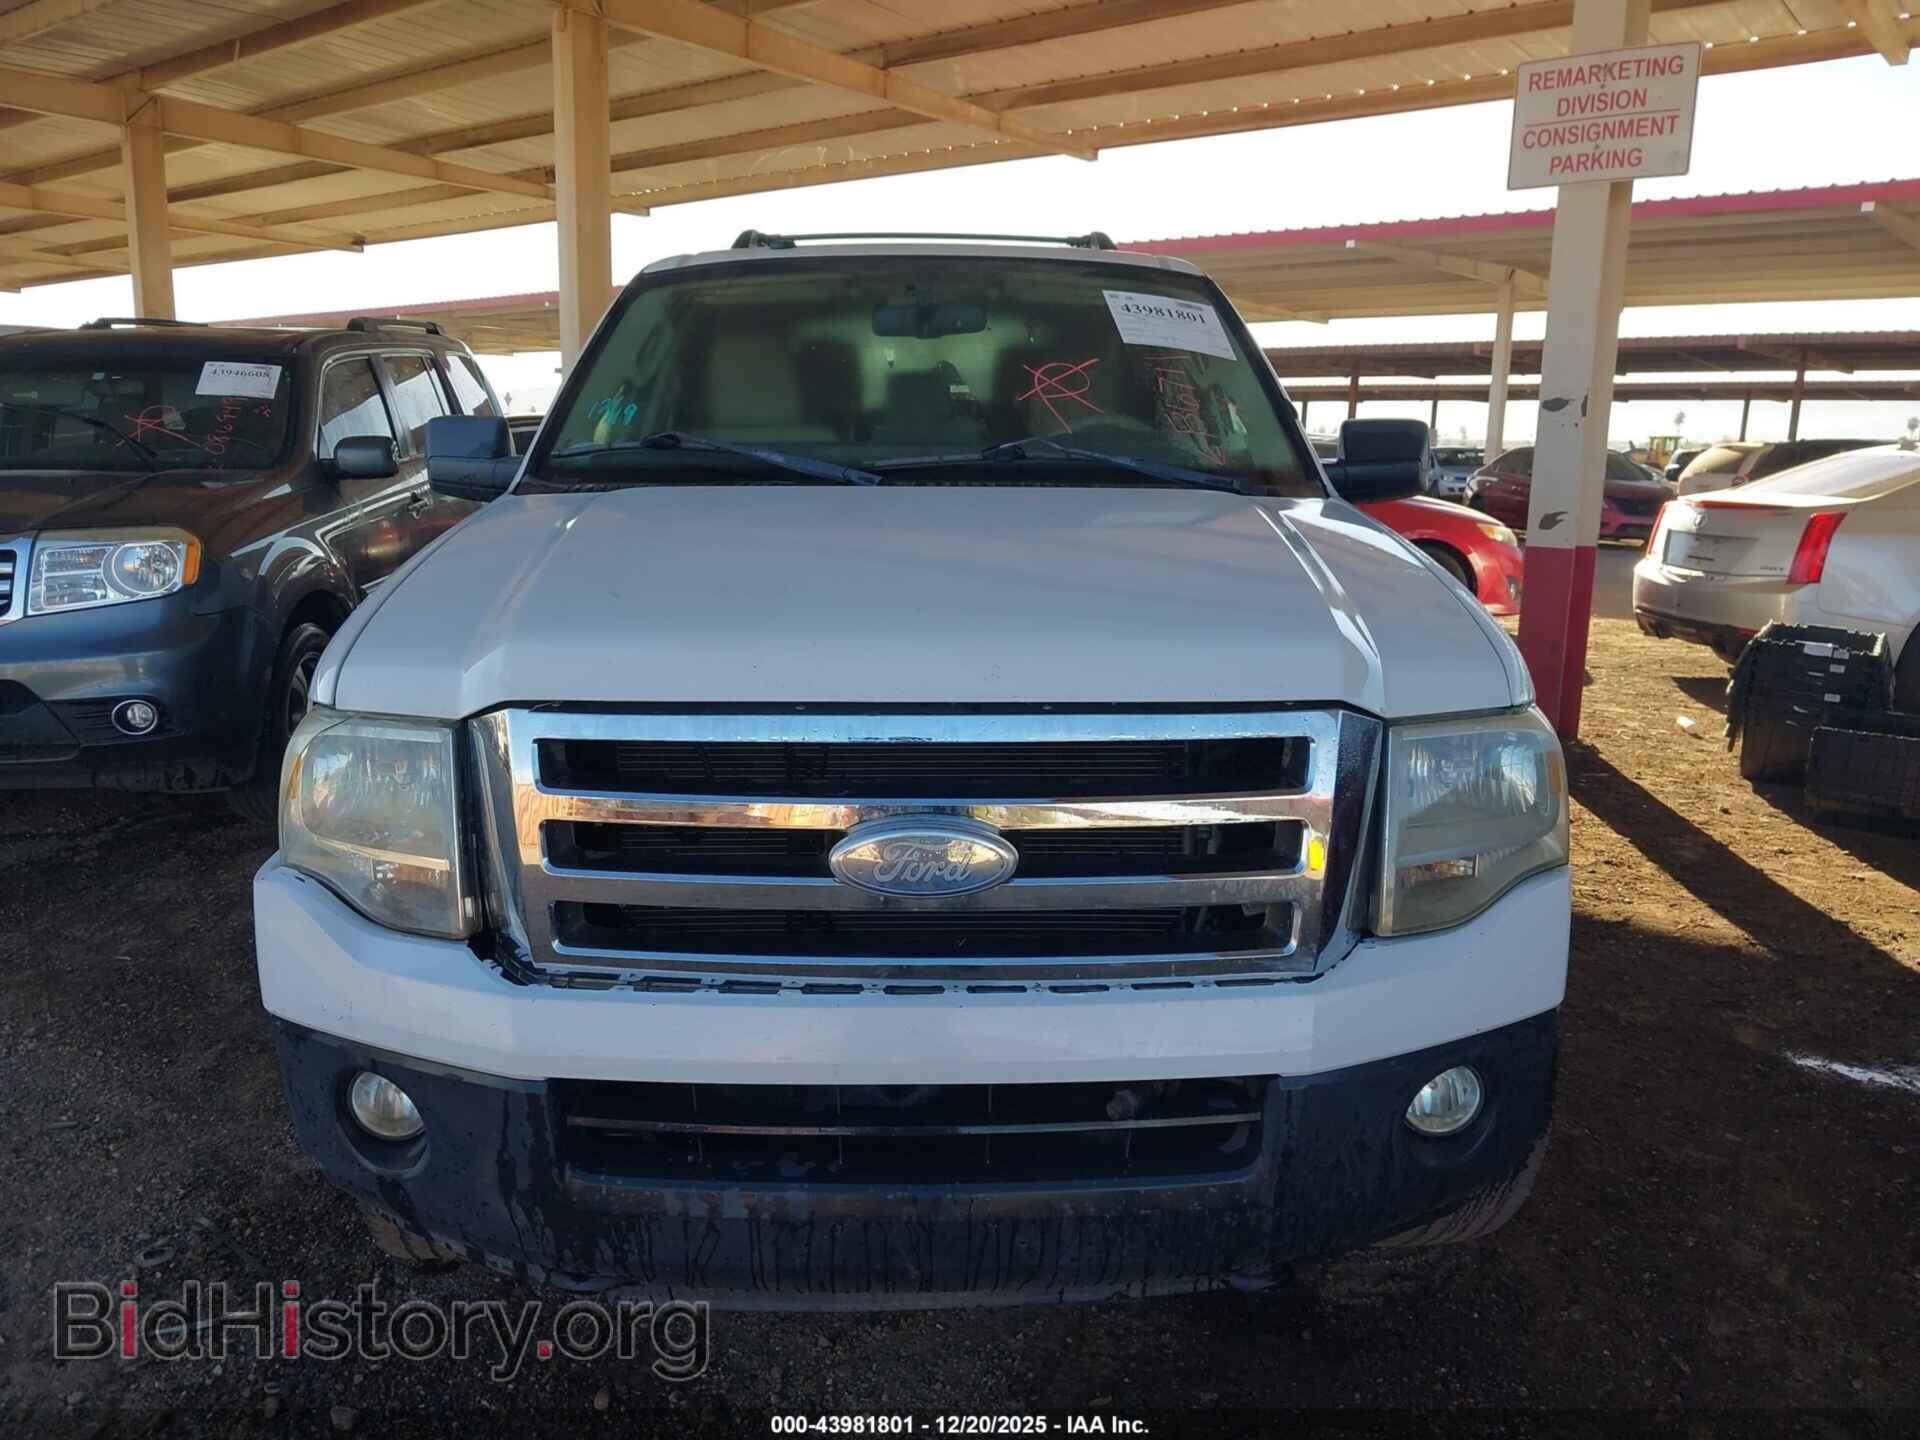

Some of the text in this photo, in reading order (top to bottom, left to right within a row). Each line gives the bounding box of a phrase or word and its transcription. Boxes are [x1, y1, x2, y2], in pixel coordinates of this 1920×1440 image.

[1528, 55, 1685, 92] REMARKETING
[1556, 88, 1648, 117] DIVISION
[1522, 115, 1680, 150] CONSIGNMENT
[1549, 148, 1643, 176] PARKING
[1121, 303, 1206, 324] 43981801
[872, 841, 974, 882] Ford
